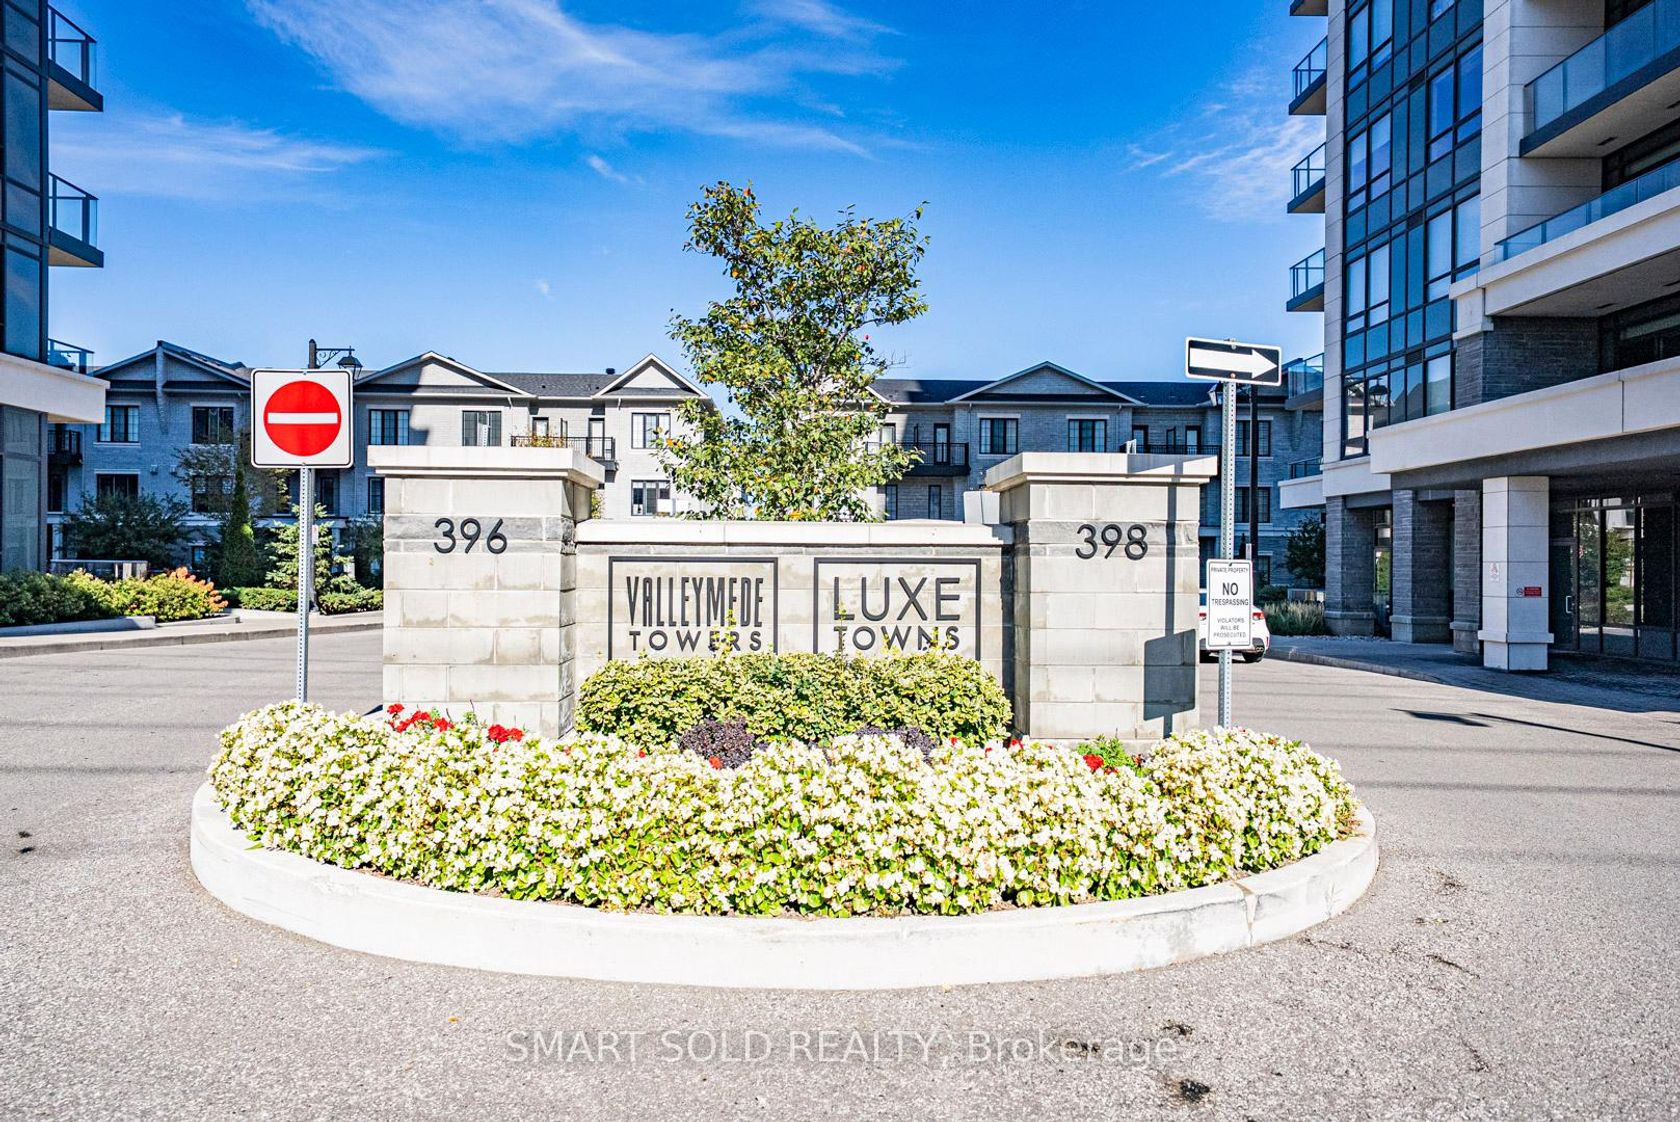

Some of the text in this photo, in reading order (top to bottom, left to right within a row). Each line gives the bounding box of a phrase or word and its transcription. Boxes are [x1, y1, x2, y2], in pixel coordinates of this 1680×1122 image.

[433, 517, 508, 555] 396
[1075, 523, 1149, 561] 398
[626, 576, 764, 627] VALLEYMEDE
[833, 576, 961, 622] LUXE
[1222, 582, 1239, 595] NO
[628, 630, 763, 652] TOWERS
[833, 625, 960, 651] TOWNS
